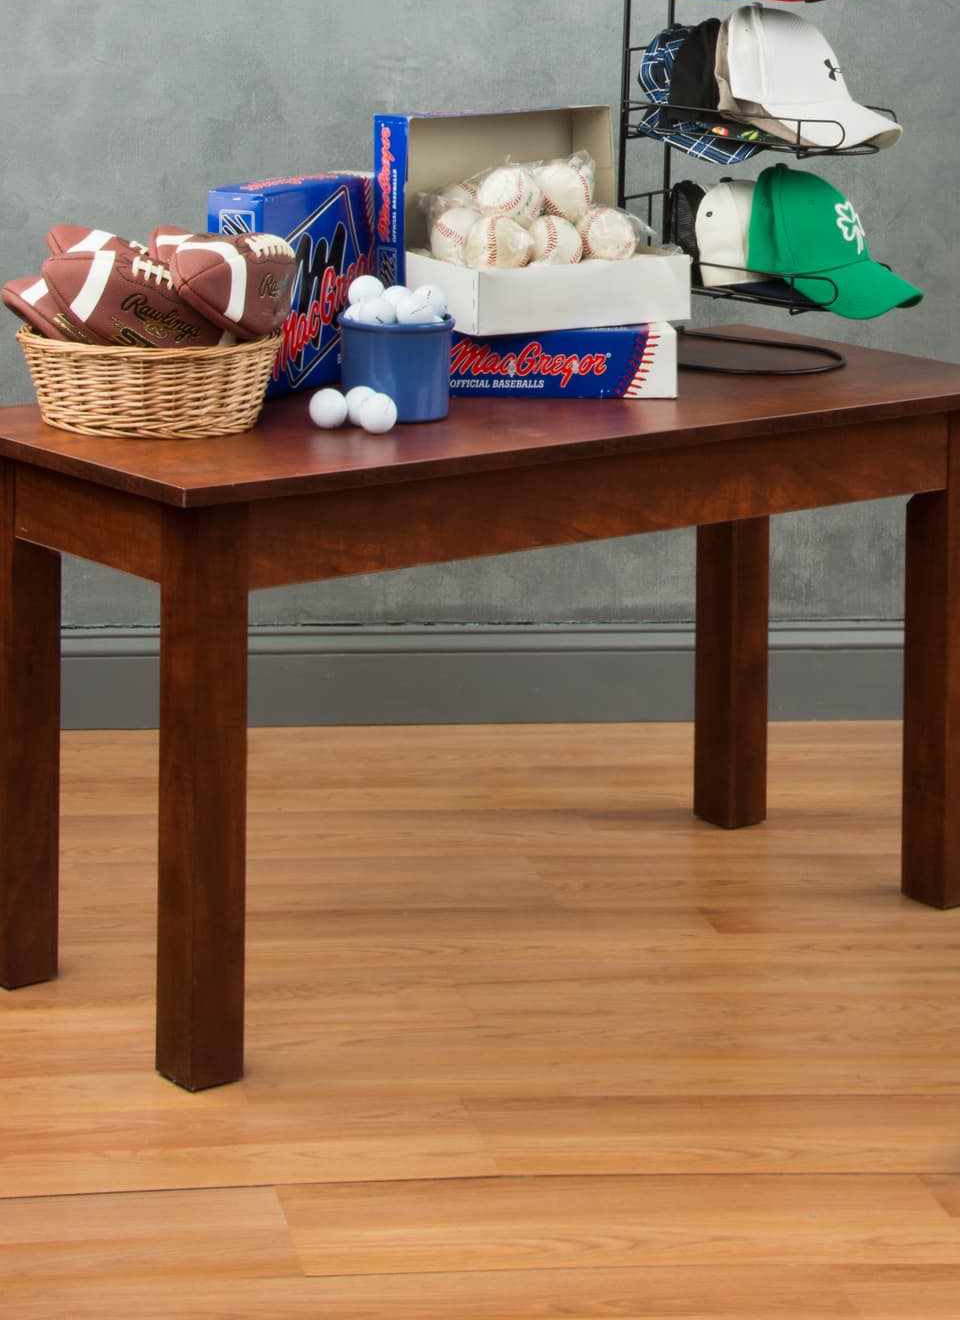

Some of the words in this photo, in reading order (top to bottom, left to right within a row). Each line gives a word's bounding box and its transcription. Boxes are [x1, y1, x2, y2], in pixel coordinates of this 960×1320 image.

[121, 292, 200, 344] Rawlings
[450, 338, 608, 389] MacGregor
[450, 380, 490, 389] OFFICIAL
[492, 380, 545, 389] BASEBALLS
